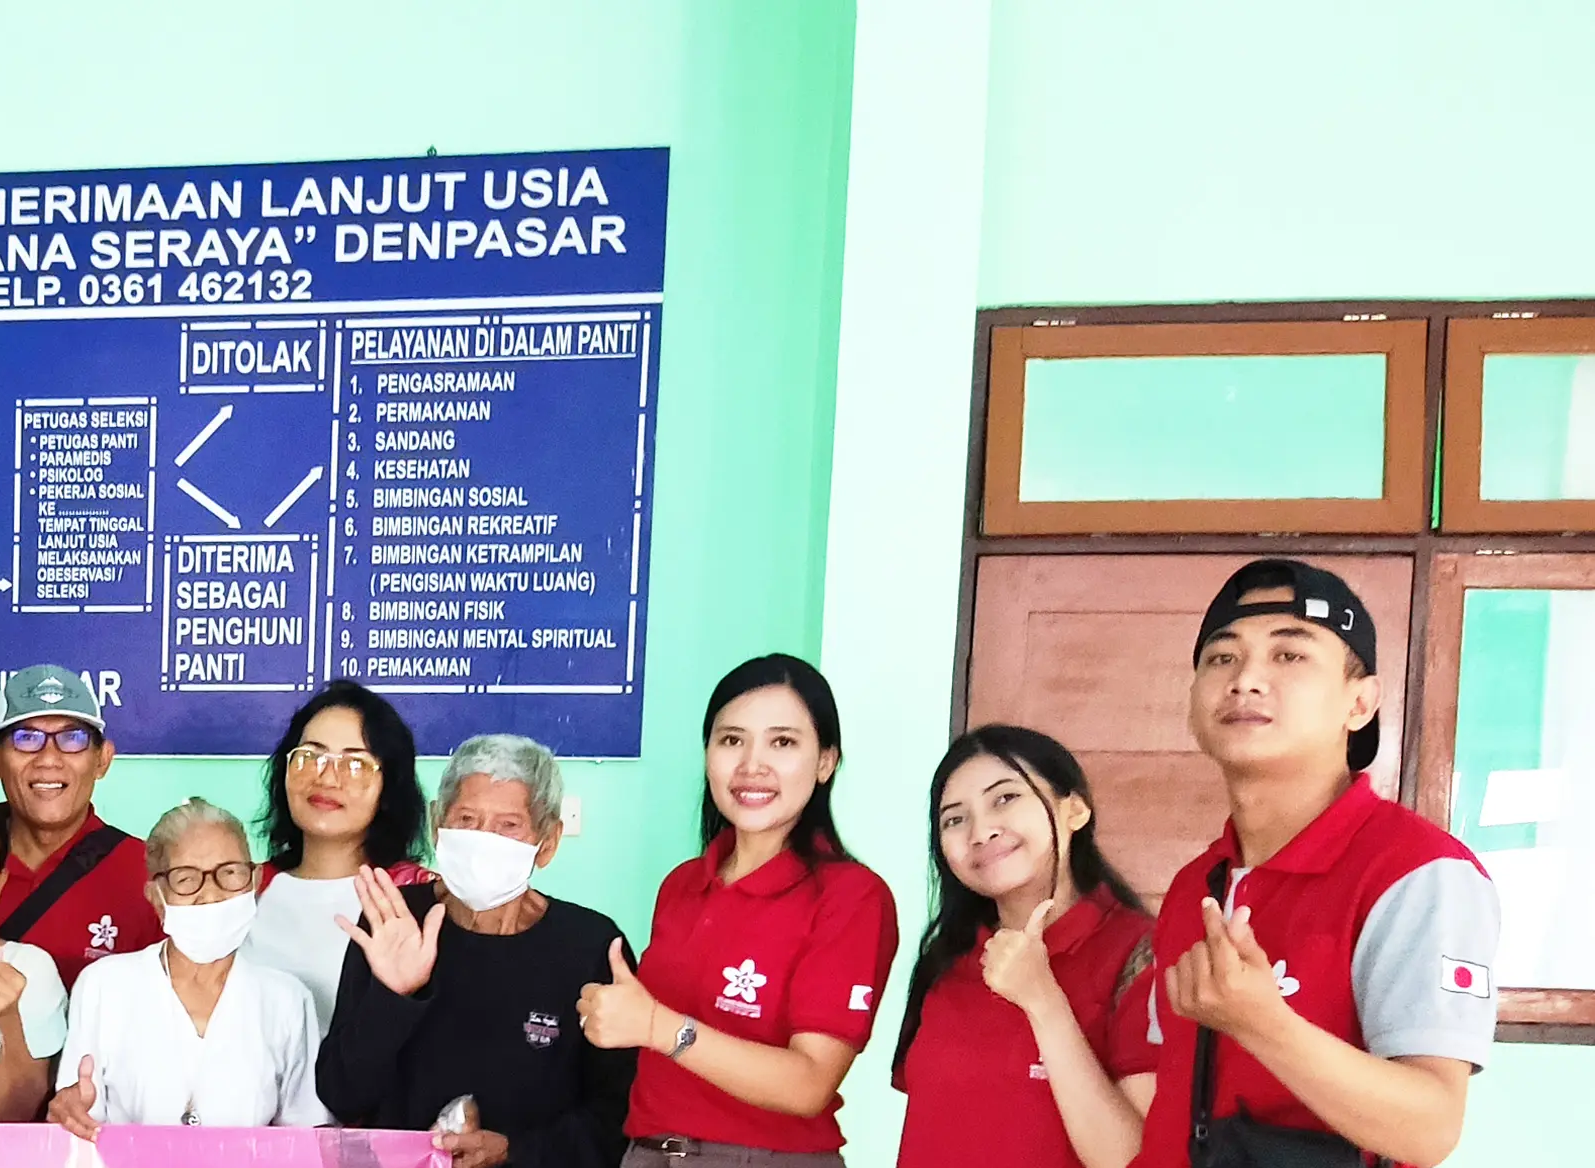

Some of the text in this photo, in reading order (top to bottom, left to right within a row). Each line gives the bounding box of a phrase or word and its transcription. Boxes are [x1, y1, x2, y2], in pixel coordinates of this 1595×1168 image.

[262, 173, 466, 216] LANJUT
[484, 168, 608, 209] USIA
[336, 213, 626, 262] DENPASAR
[80, 273, 165, 308] 0361
[178, 270, 315, 304] 462132
[350, 321, 636, 362] PELAYANAN DI DALAM PANTI
[193, 340, 311, 374] DITOLAK
[378, 372, 514, 393] PENGASRAMAAN
[24, 411, 147, 428] PETUGAS SELEKSI
[377, 401, 490, 422] PERMAKANAN
[40, 434, 137, 449] PETUGAS PANTI
[376, 430, 454, 451] SANDANG
[40, 451, 111, 466] PARAMEDIS
[40, 468, 103, 482] PSIKOLOG
[375, 459, 469, 479] KESEHATAN
[39, 484, 144, 499] PEKERJA SOSIAL
[374, 487, 527, 507] BIMBINGAN SOSIAL
[39, 502, 55, 515] KE
[38, 517, 144, 532] TEMPAT TINGGAL
[373, 515, 557, 536] BIMBINGAN REKREATIF
[38, 534, 118, 548] LANJUT USIA
[38, 550, 140, 565] MELAKSANAKAN
[178, 545, 294, 573] DITERIMA
[372, 544, 582, 564] BIMBINGAN KETRAMPILAN
[38, 567, 115, 581] OBESERVASI
[381, 573, 466, 592] PENGISIAN
[471, 573, 528, 591] WAKTU
[37, 584, 88, 598] SELEKSI
[177, 581, 286, 609] SEBAGAI
[342, 601, 504, 620] 8. BIMBINGAN FISIK
[176, 617, 302, 645] PENGHUNI
[341, 629, 616, 648] 9. BIMBINGAN MENTAL SPIRITUAL
[176, 653, 244, 680] PANTI
[341, 658, 470, 676] 10. PEMAKAMAN
